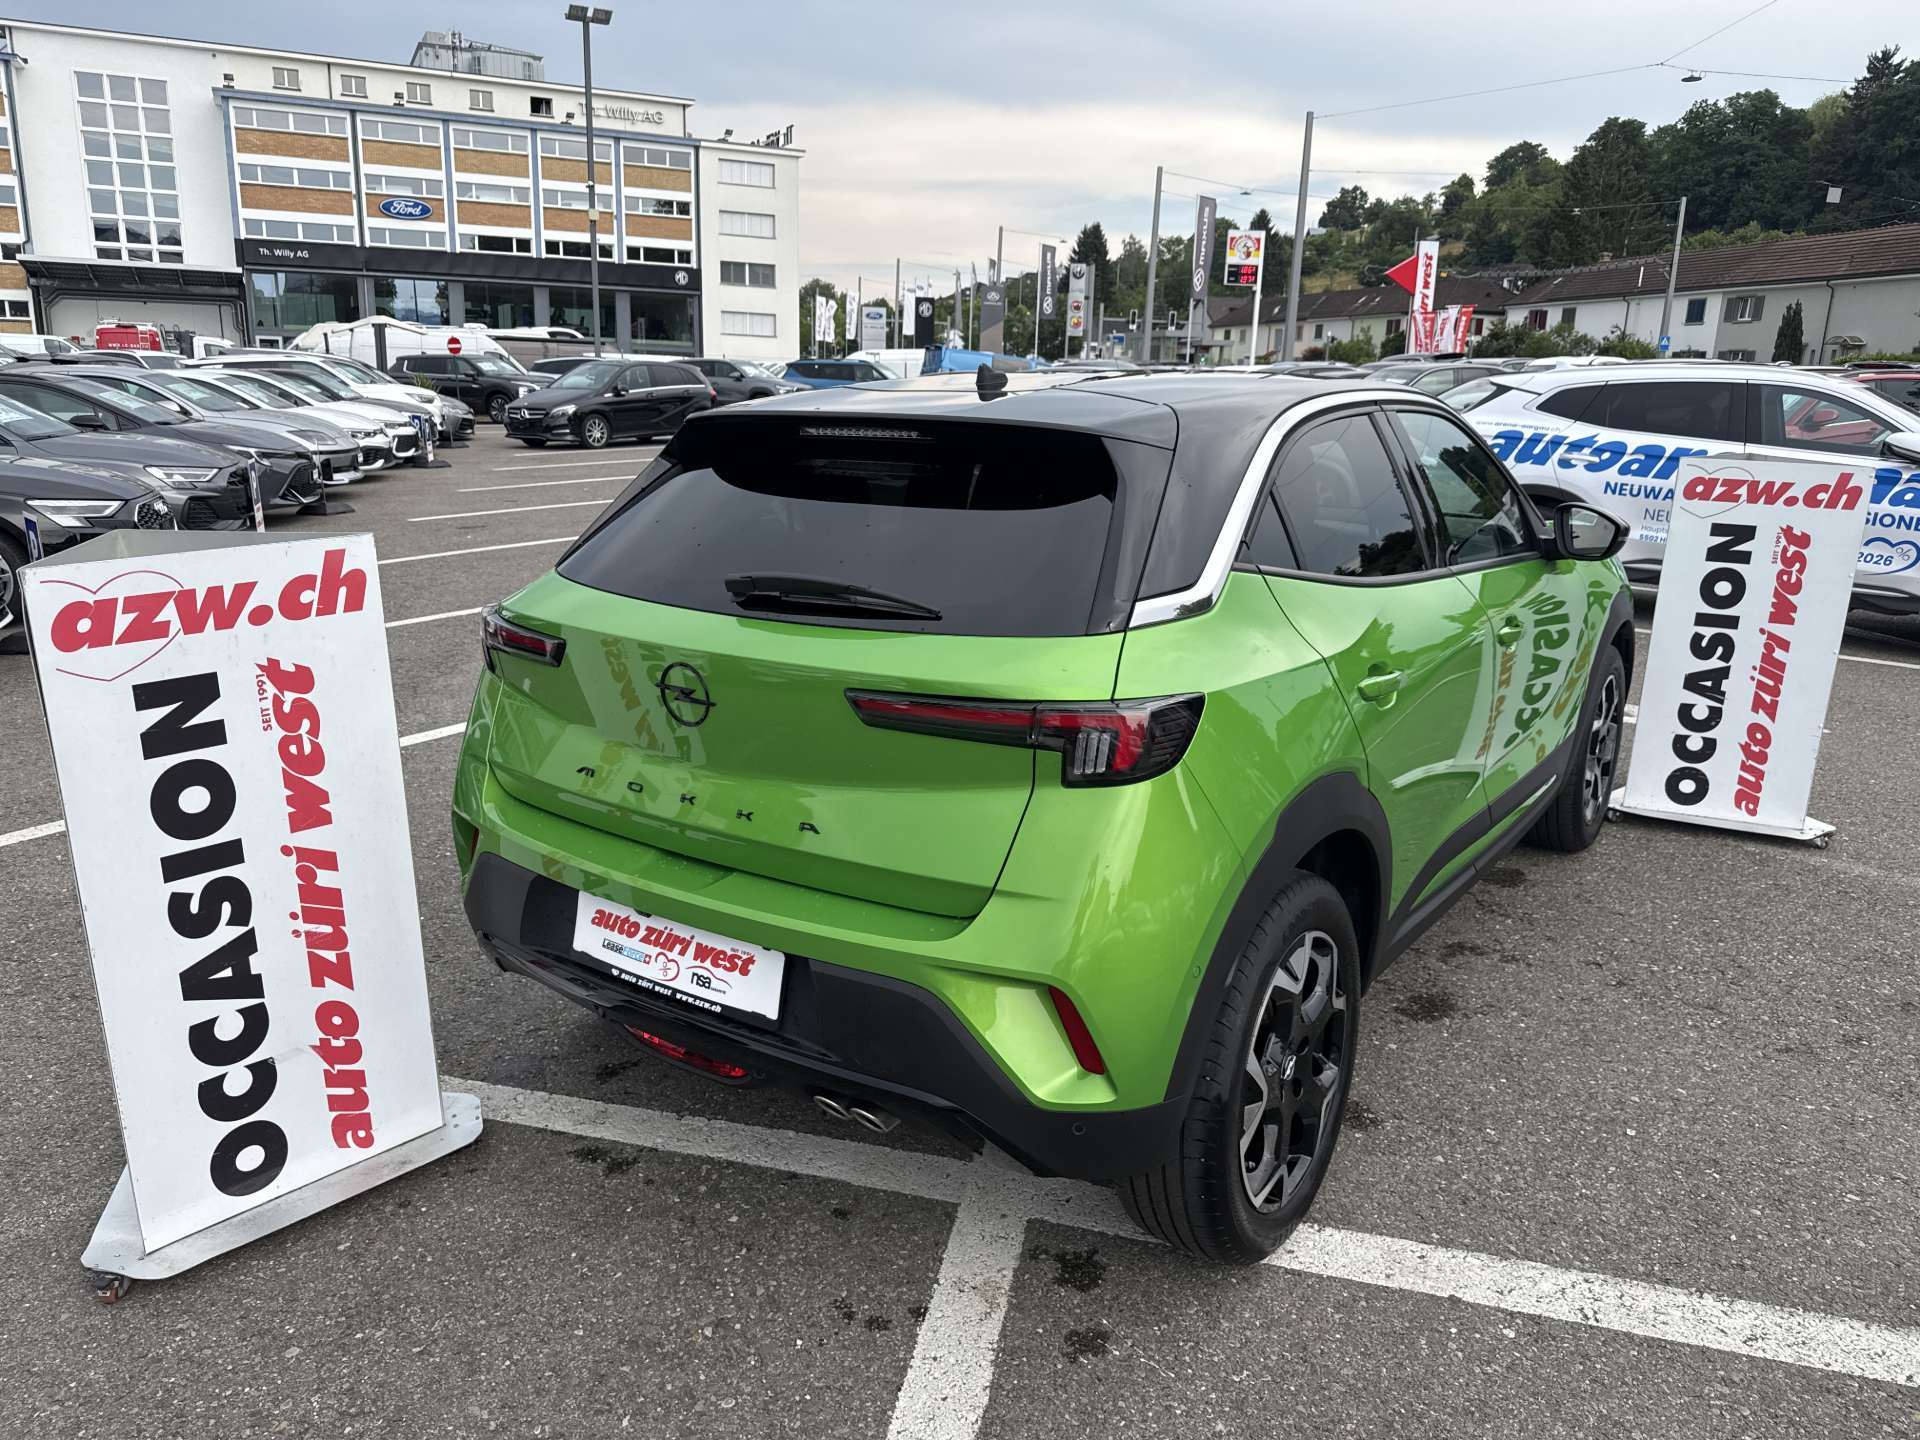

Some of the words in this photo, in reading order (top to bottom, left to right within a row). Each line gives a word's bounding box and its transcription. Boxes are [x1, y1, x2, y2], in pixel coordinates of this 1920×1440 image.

[605, 104, 639, 124] Willy
[642, 110, 664, 124] AG
[389, 199, 422, 216] Ford
[258, 247, 271, 256] Th.
[273, 248, 294, 259] Willy
[296, 250, 309, 258] AG
[918, 301, 933, 318] MG
[1682, 472, 1863, 511] azw.ch
[1767, 524, 1811, 626] west
[1857, 551, 1894, 566] 2026
[50, 549, 367, 653] azw.ch
[255, 673, 269, 702] 1991
[1665, 522, 1757, 806] OCCASION
[1750, 627, 1791, 722] züri
[254, 656, 333, 833] west
[260, 706, 272, 732] SEIT
[575, 765, 821, 835] MOKKA
[1734, 722, 1772, 817] auto
[132, 671, 289, 1197] OCCASION
[280, 844, 355, 991] züri
[591, 908, 641, 939] auto
[639, 925, 695, 957] züri
[693, 941, 756, 977] west
[620, 972, 637, 983] auto
[637, 978, 654, 990] züri
[654, 983, 672, 997] west
[675, 991, 722, 1014] www.azw.ch
[690, 971, 712, 990] nsa
[308, 1000, 375, 1149] auto
